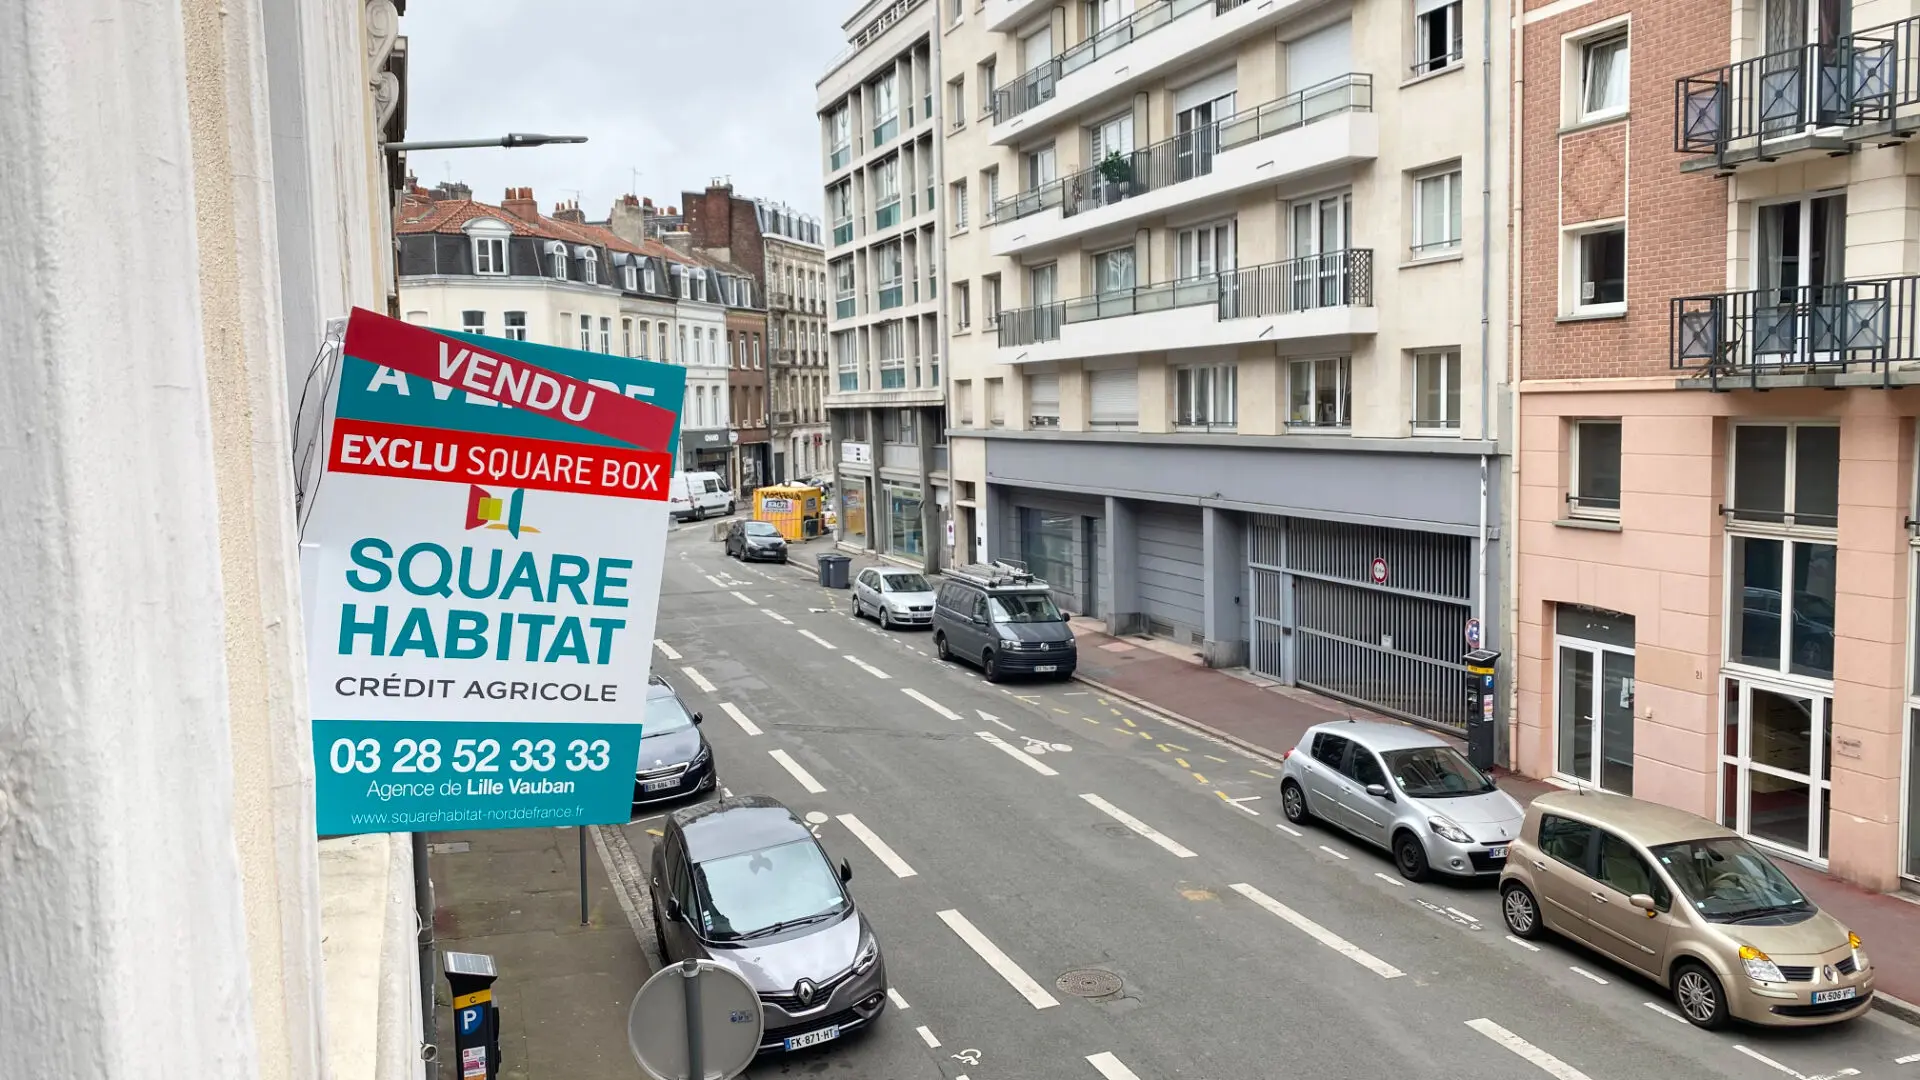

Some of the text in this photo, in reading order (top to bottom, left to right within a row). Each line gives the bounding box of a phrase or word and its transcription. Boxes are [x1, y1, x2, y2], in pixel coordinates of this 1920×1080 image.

[439, 341, 596, 422] VENDU
[340, 433, 661, 491] EXCLU SQUARE BOX
[345, 537, 633, 608] SQUARE
[337, 603, 627, 666] HABITAT
[335, 672, 618, 702] CRÉDIT AGRICOLE
[329, 738, 611, 774] 03 28 52 33 33
[366, 778, 575, 802] Agence de Lille Vauban
[351, 804, 584, 825] www.squarehabitat-norddefrance.fr
[463, 1009, 477, 1030] P
